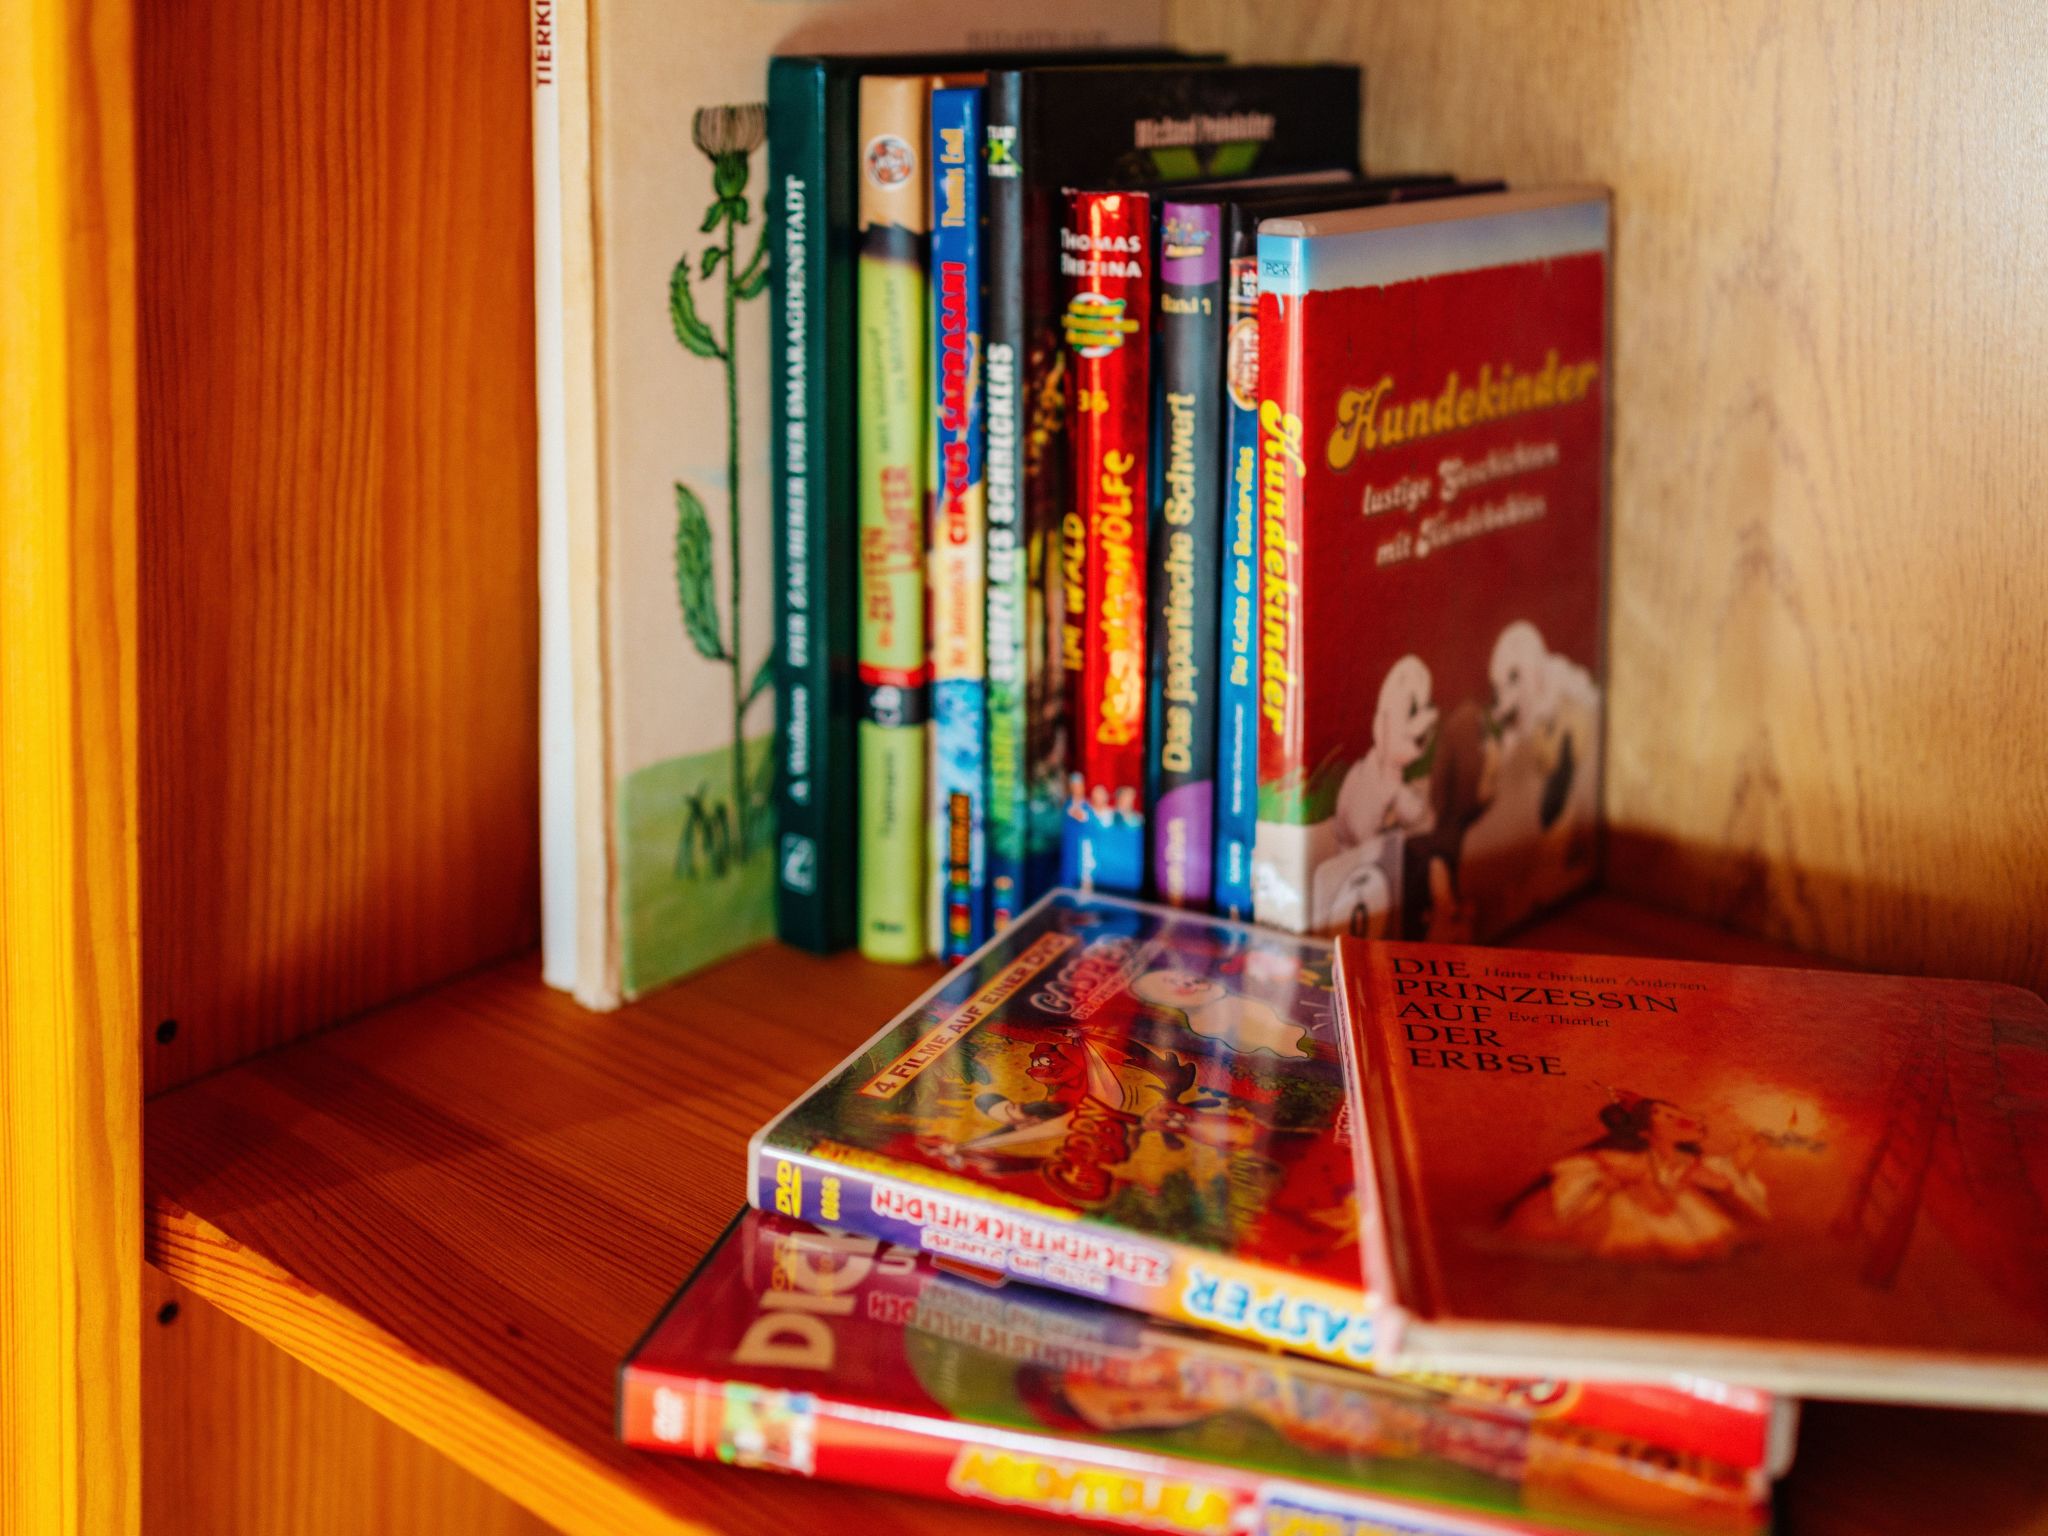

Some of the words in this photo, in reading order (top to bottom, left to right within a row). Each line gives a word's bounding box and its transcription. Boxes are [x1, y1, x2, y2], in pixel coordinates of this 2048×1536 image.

[1061, 227, 1141, 253] THOMAS
[941, 261, 968, 431] SARRASANI
[1327, 348, 1599, 470] Hundekinder
[1163, 392, 1196, 526] Schwert
[1362, 476, 1432, 517] lustige
[1062, 511, 1086, 614] WALD
[1260, 398, 1306, 737] Hundekinder
[1376, 530, 1412, 567] mit
[1234, 559, 1250, 593] der
[1162, 531, 1198, 704] japanische
[1162, 706, 1193, 773] Das
[1392, 957, 1471, 979] DIE
[1484, 966, 1532, 980] Hans
[1537, 968, 1617, 986] Christian
[1626, 976, 1708, 992] Andersen
[1396, 978, 1680, 1014] PRINZESSIN
[1397, 1001, 1493, 1024] AUF
[1508, 1012, 1540, 1025] Eve
[1546, 1013, 1611, 1028] Tharlet
[876, 1076, 898, 1094] 4
[888, 1034, 951, 1080] FILME
[949, 1005, 983, 1036] AUF
[981, 966, 1030, 1004] EINER
[1403, 1023, 1504, 1048] DER
[1408, 1048, 1567, 1077] ERBSE
[775, 1160, 799, 1217] DVD
[874, 1188, 1163, 1277] ZEICHENTRICKHELDEN
[1184, 1265, 1375, 1357] CASPER
